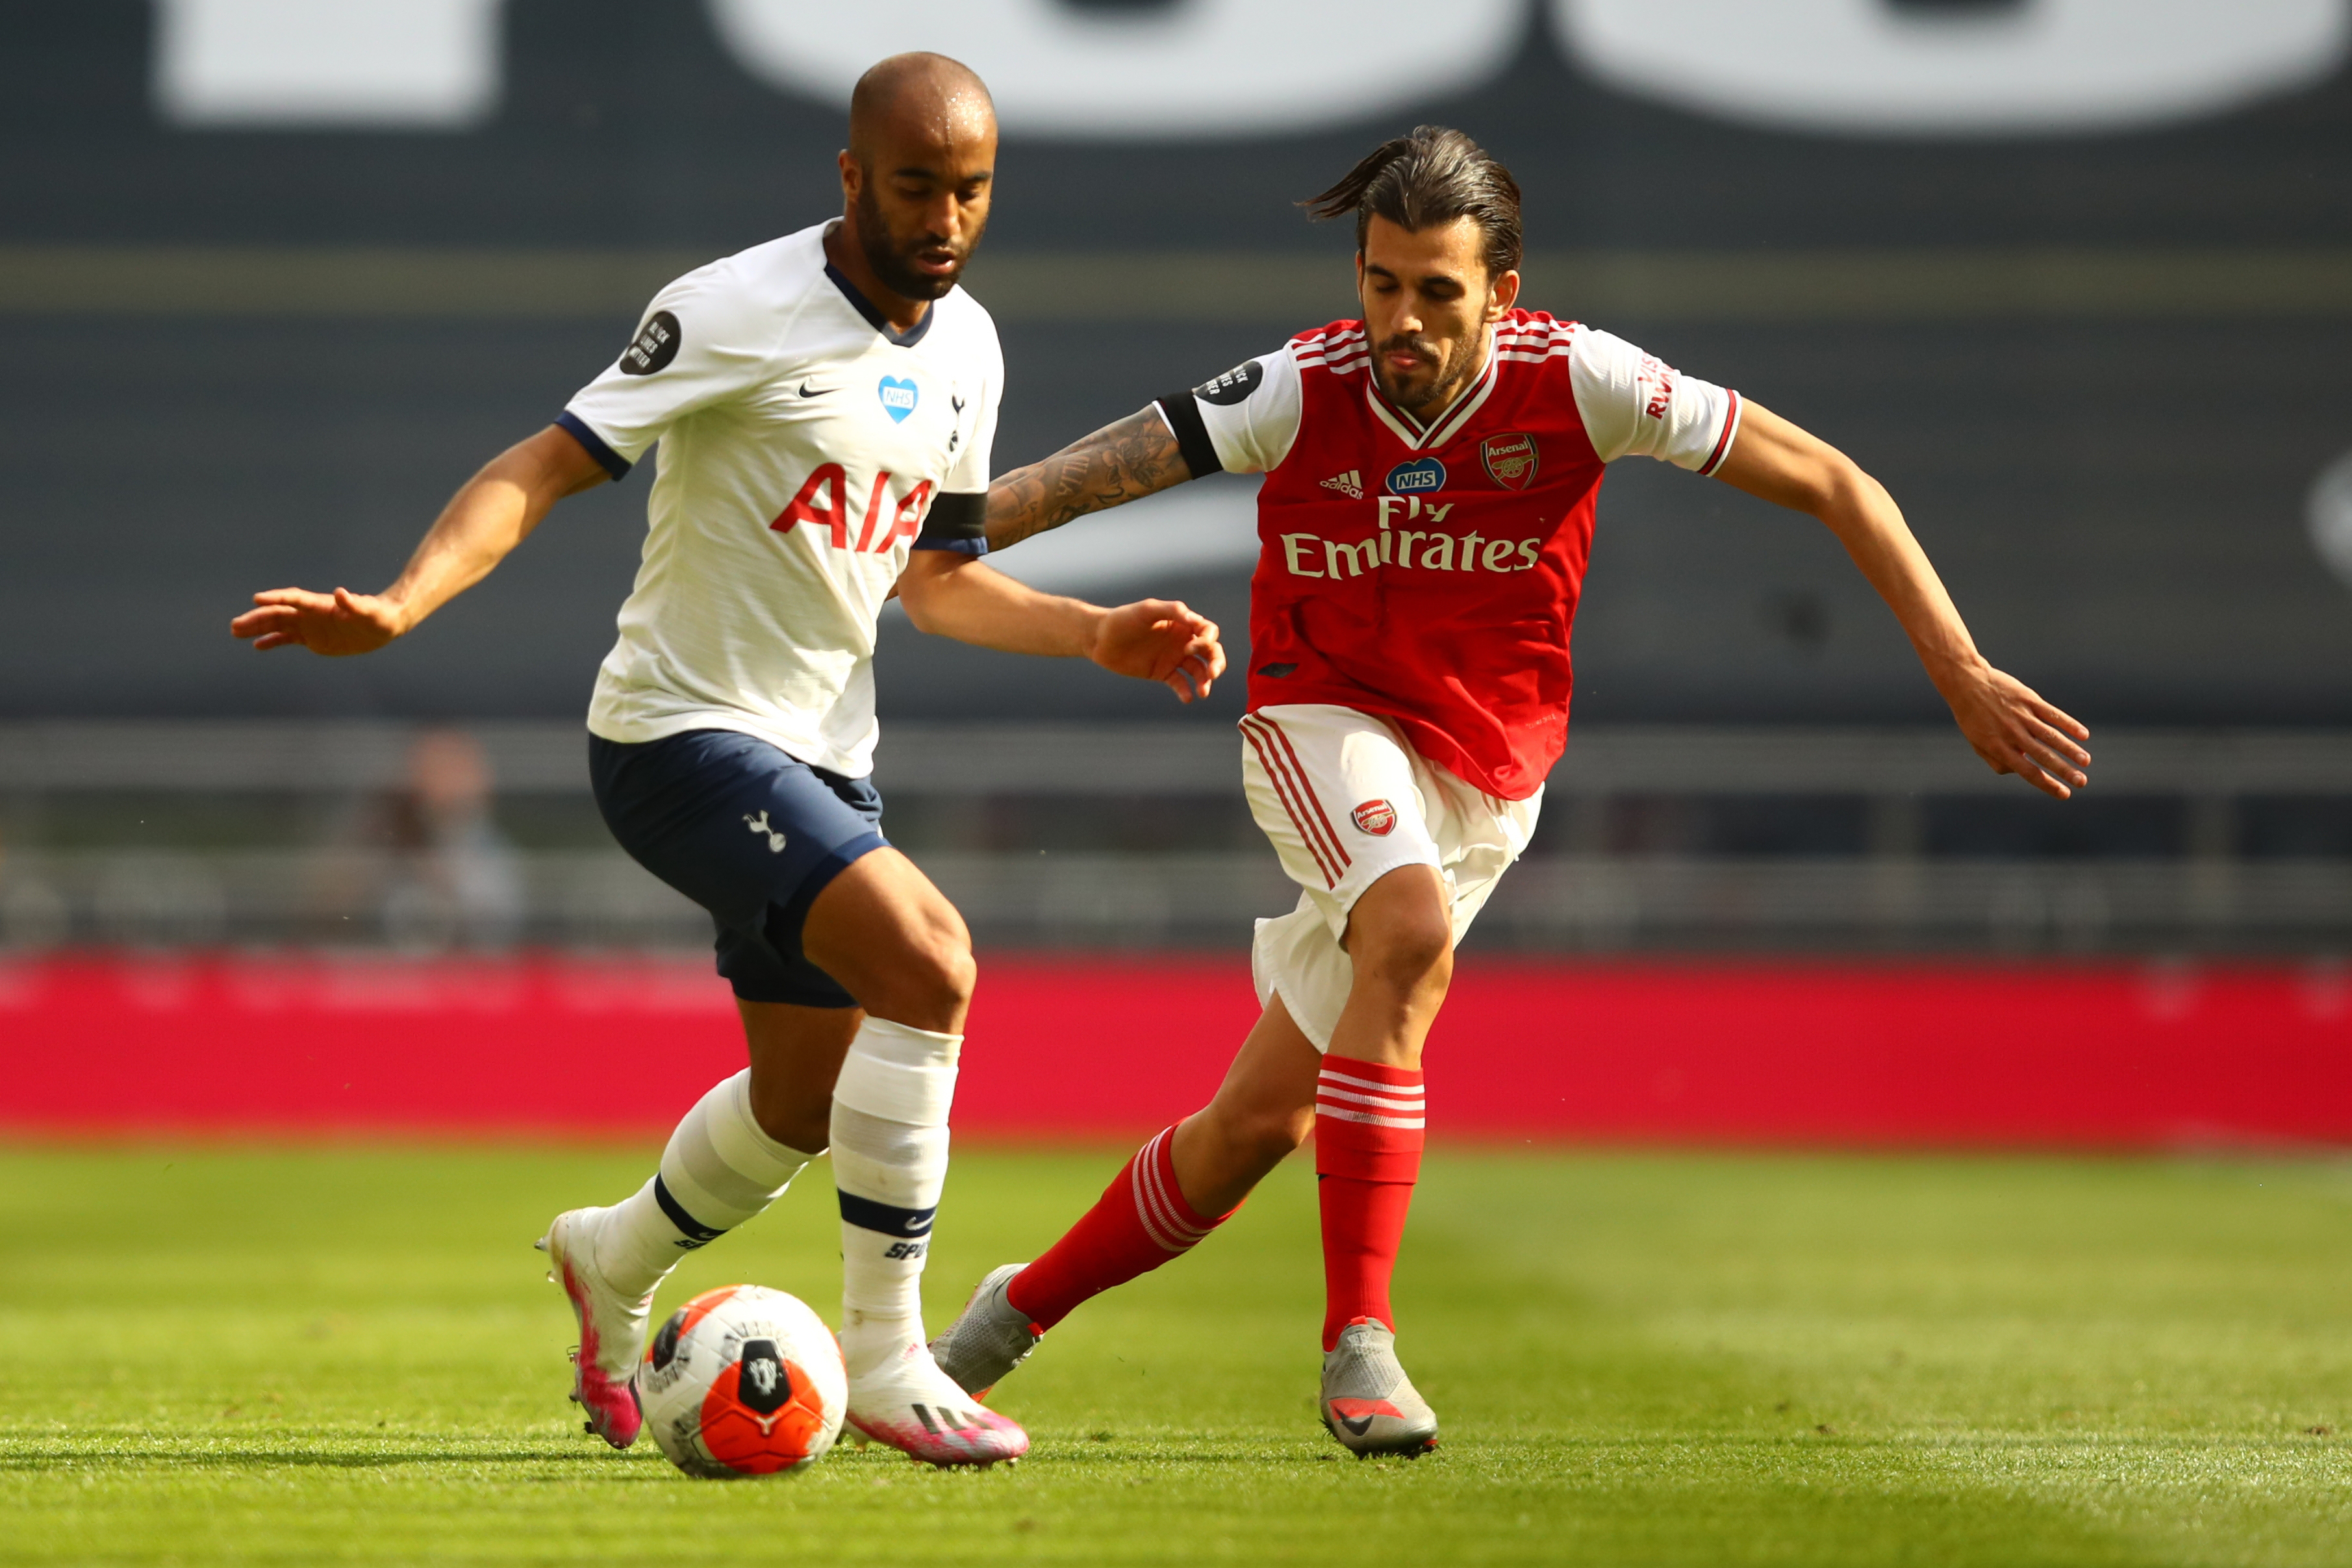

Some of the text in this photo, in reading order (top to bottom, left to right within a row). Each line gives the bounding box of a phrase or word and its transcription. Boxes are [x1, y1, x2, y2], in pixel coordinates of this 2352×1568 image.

[886, 389, 911, 405] NHS
[1489, 440, 1529, 457] Arsenal
[1320, 479, 1364, 499] adidas
[1398, 472, 1435, 488] NHS
[769, 462, 932, 553] AIA
[1378, 496, 1455, 529] Fly
[1280, 529, 1541, 580] Emirates
